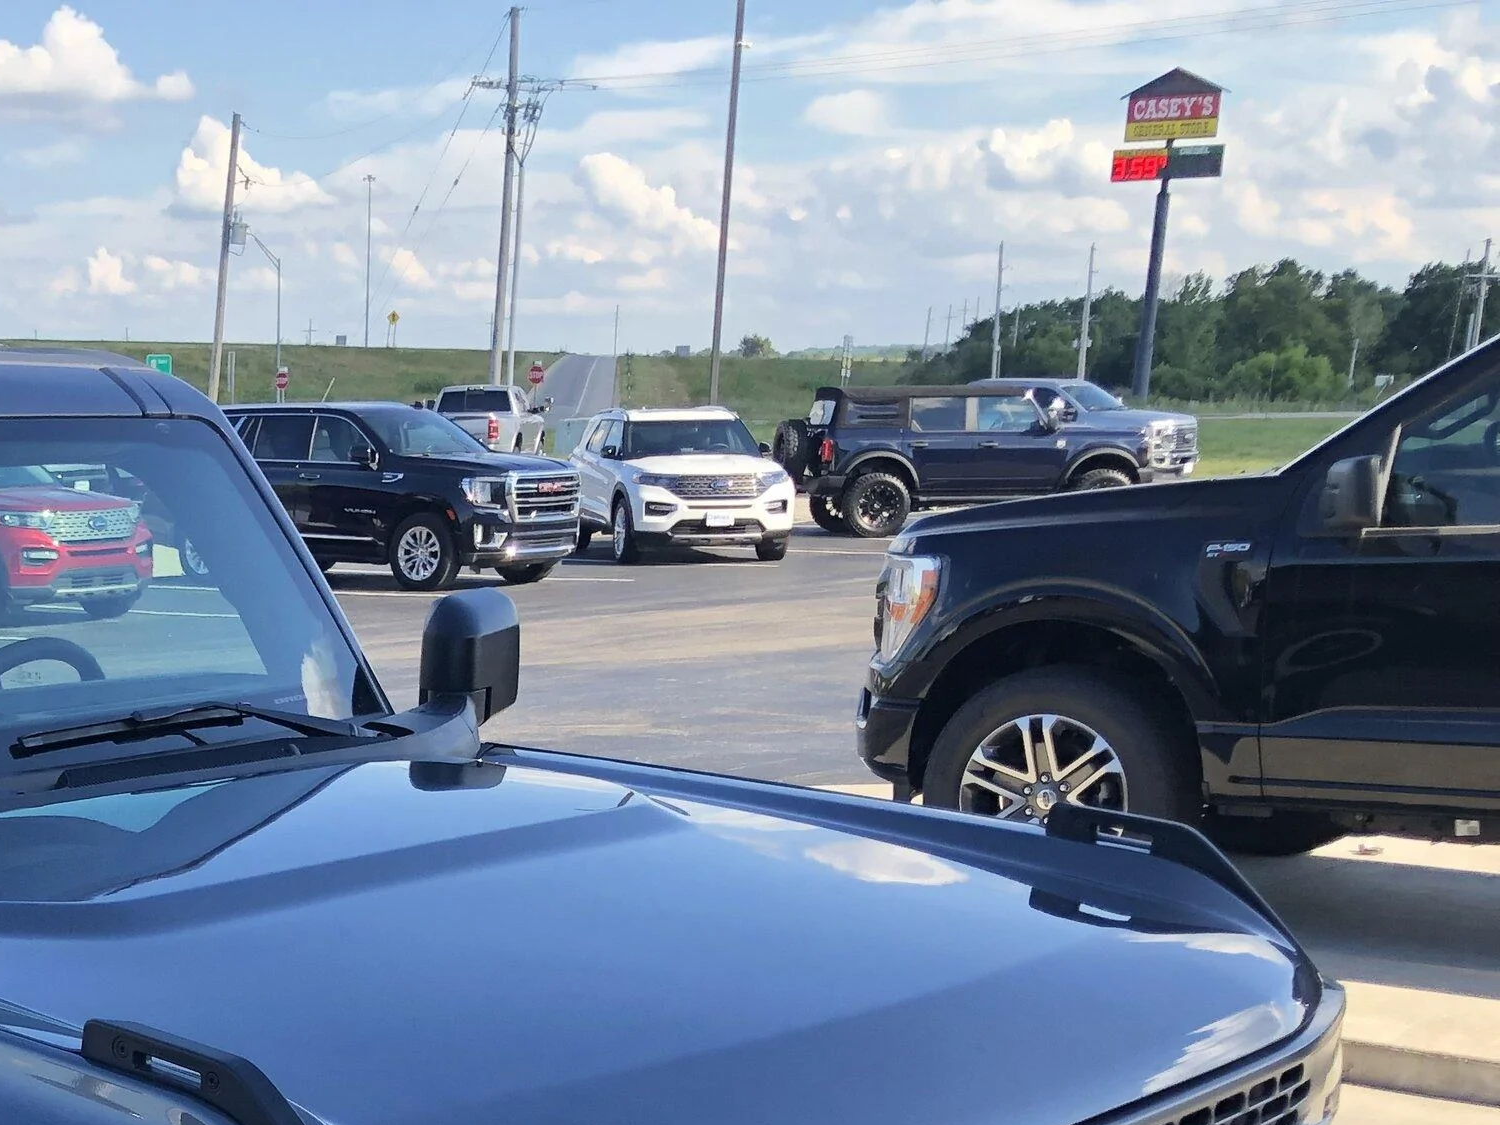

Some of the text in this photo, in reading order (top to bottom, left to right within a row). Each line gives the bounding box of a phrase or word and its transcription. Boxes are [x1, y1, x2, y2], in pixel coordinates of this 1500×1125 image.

[1133, 95, 1214, 120] CASEY'S
[529, 371, 542, 379] STOP
[538, 482, 565, 493] GMC
[1206, 543, 1251, 552] F-150
